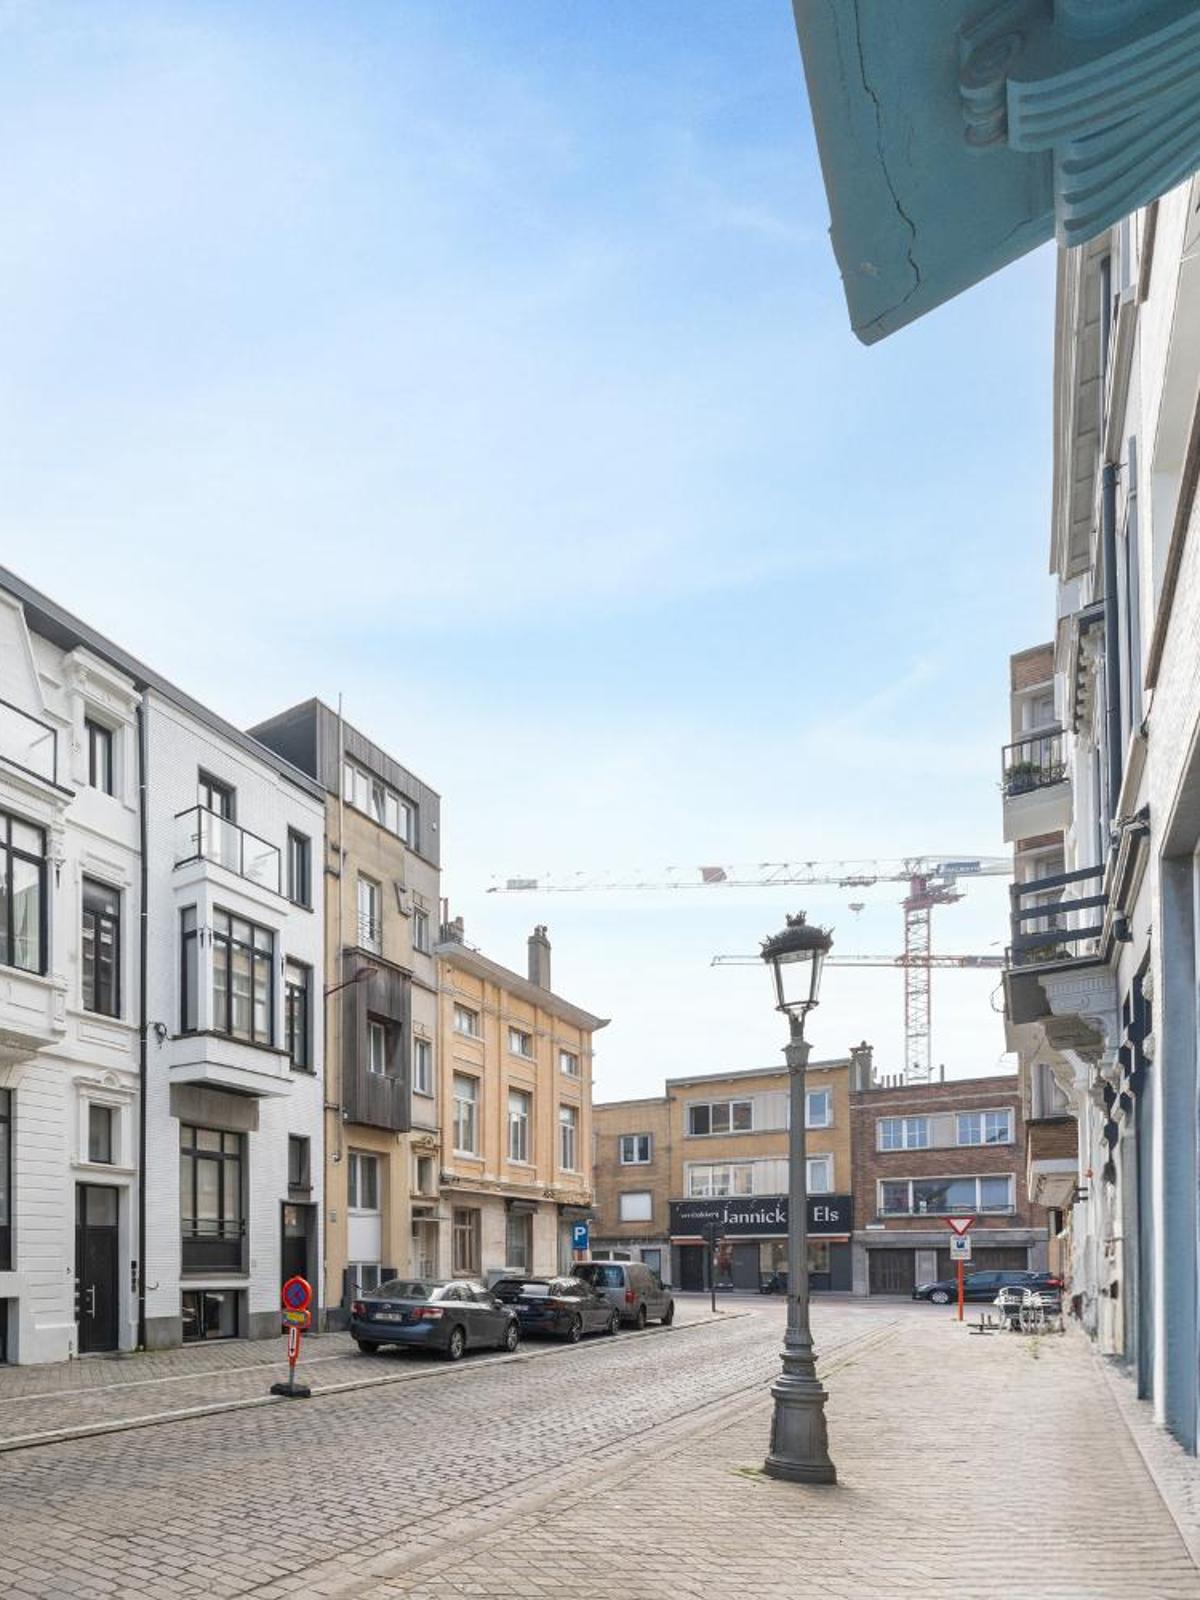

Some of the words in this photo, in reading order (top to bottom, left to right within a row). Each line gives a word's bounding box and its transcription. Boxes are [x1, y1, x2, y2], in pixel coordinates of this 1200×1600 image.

[722, 1208, 787, 1225] Jannick
[813, 1206, 840, 1222] Els
[574, 1226, 586, 1241] P
